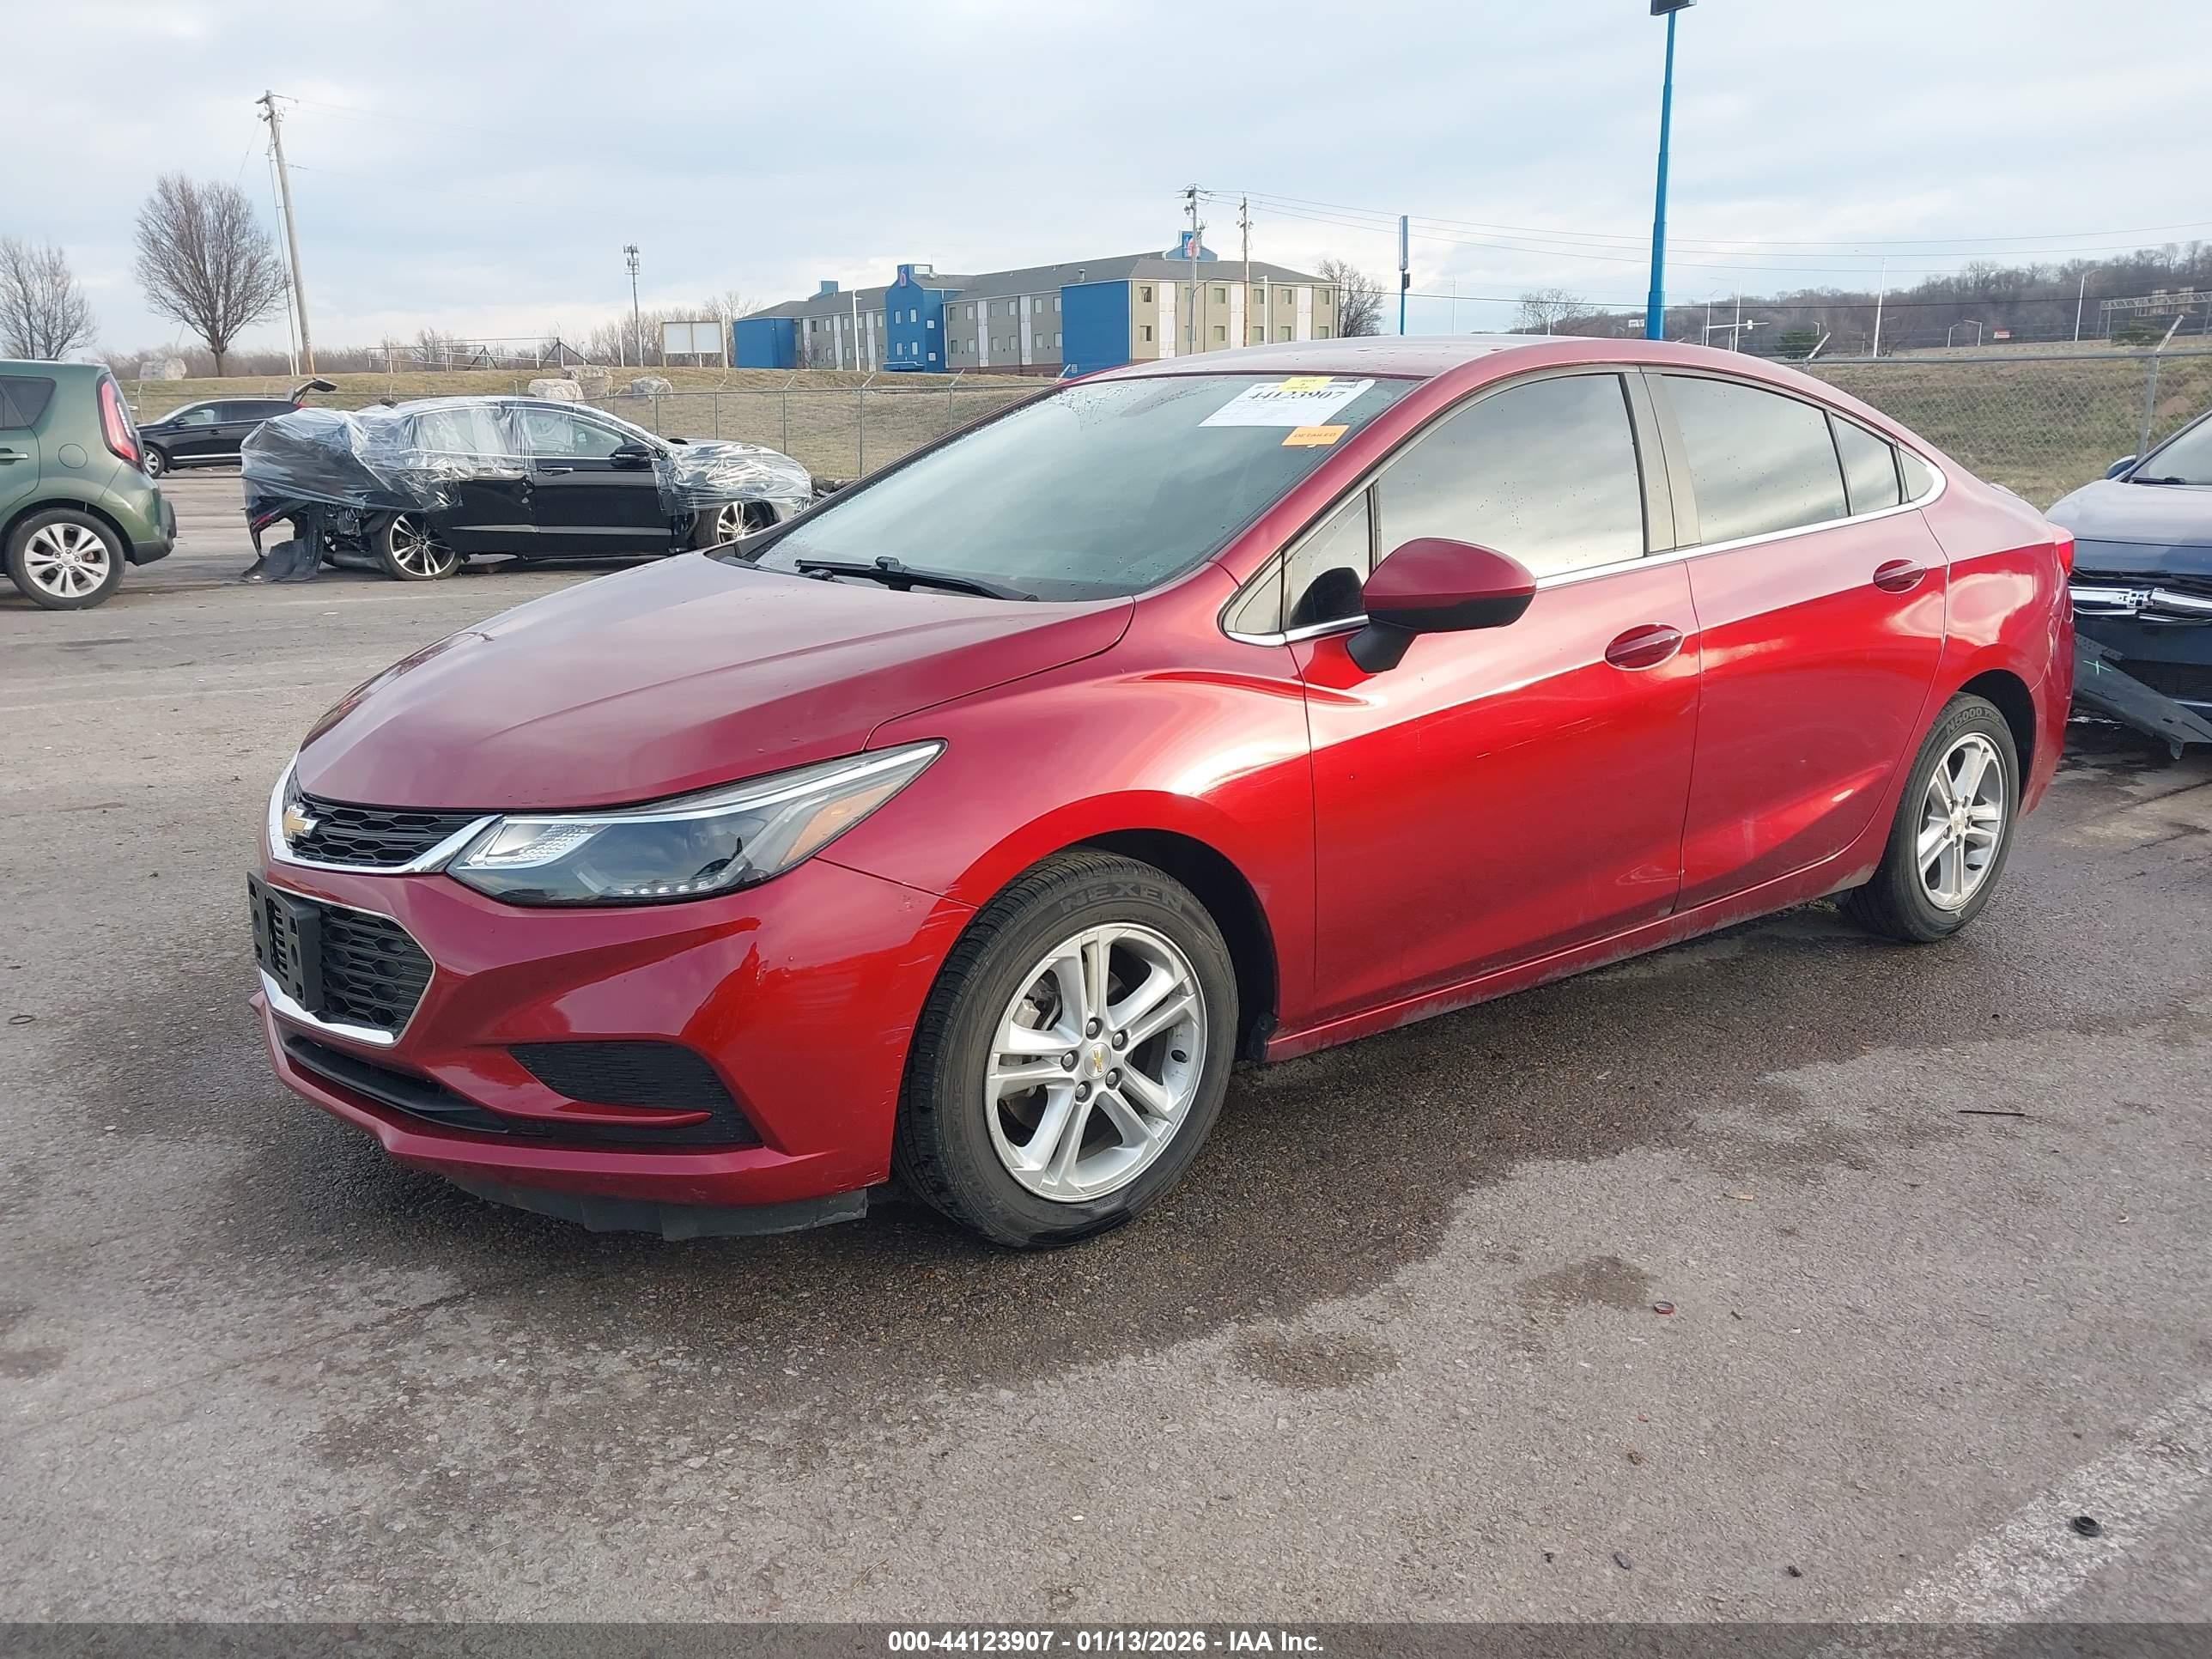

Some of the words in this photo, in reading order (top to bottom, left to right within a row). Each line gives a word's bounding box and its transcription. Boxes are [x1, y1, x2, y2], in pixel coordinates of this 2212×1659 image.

[1249, 391, 1347, 399] 44123907
[1945, 708, 1982, 736] N5000
[1060, 883, 1182, 913] NEXEN
